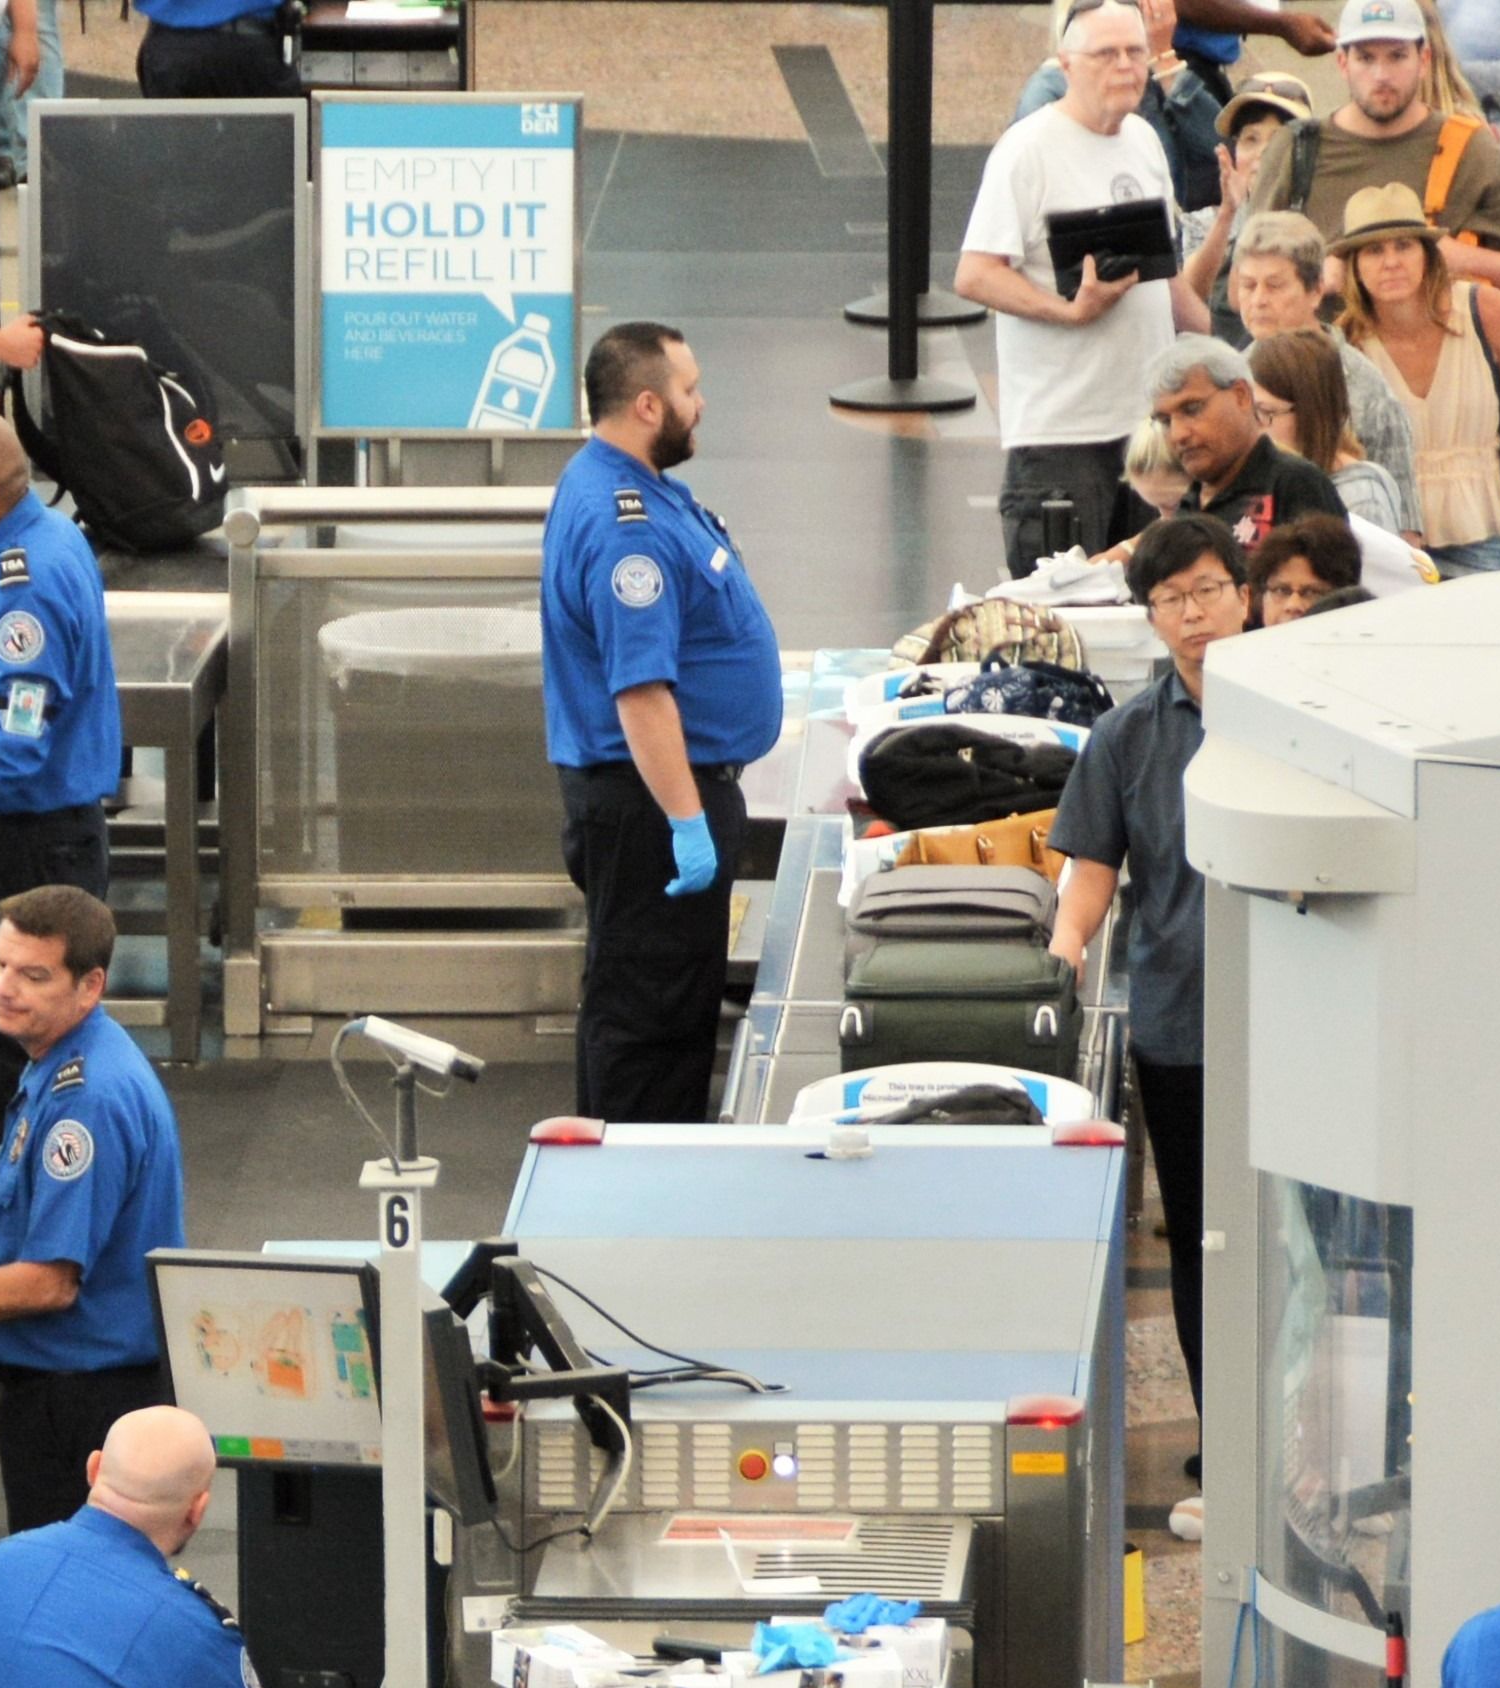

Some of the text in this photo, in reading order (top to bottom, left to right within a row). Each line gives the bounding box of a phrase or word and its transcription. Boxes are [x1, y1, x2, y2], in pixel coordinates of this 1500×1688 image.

[521, 119, 559, 135] DEN
[344, 157, 547, 192] EMPTY IT
[344, 201, 547, 239] HOLD IT
[344, 248, 547, 281] REFILL IT
[344, 312, 478, 326] POUR OUT WATER
[344, 329, 467, 344] AND BEVERAGES
[344, 347, 384, 361] HERE
[617, 498, 643, 511] TSA
[386, 1196, 410, 1247] 6
